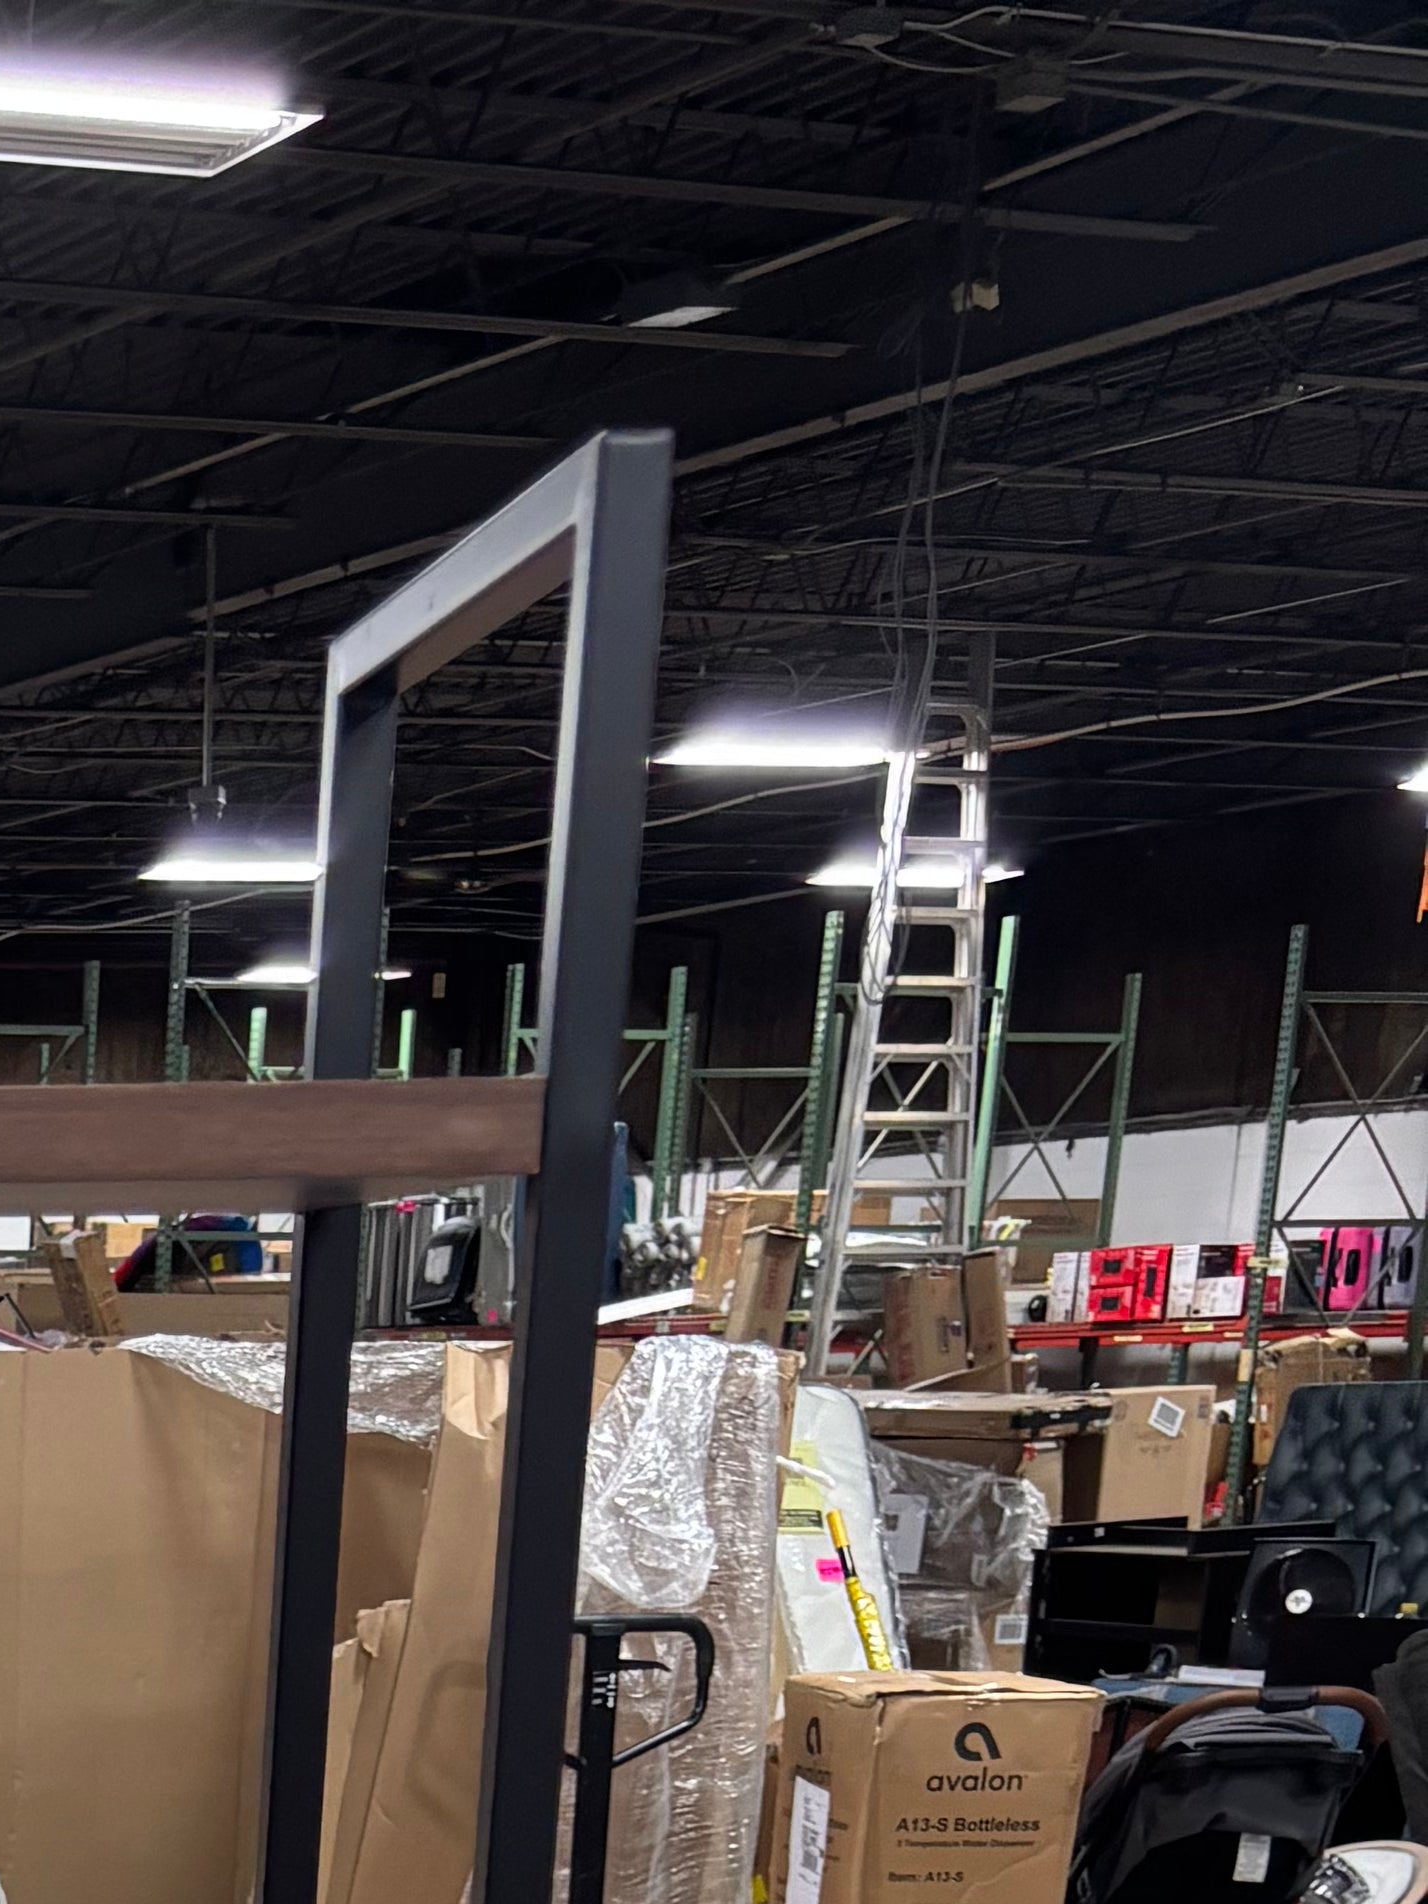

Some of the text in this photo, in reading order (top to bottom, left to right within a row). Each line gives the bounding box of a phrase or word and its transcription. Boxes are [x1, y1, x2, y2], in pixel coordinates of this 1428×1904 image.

[925, 1766, 1024, 1792] avalon
[895, 1816, 1041, 1833] A13-S Bottleless
[923, 1871, 965, 1883] A13-S
